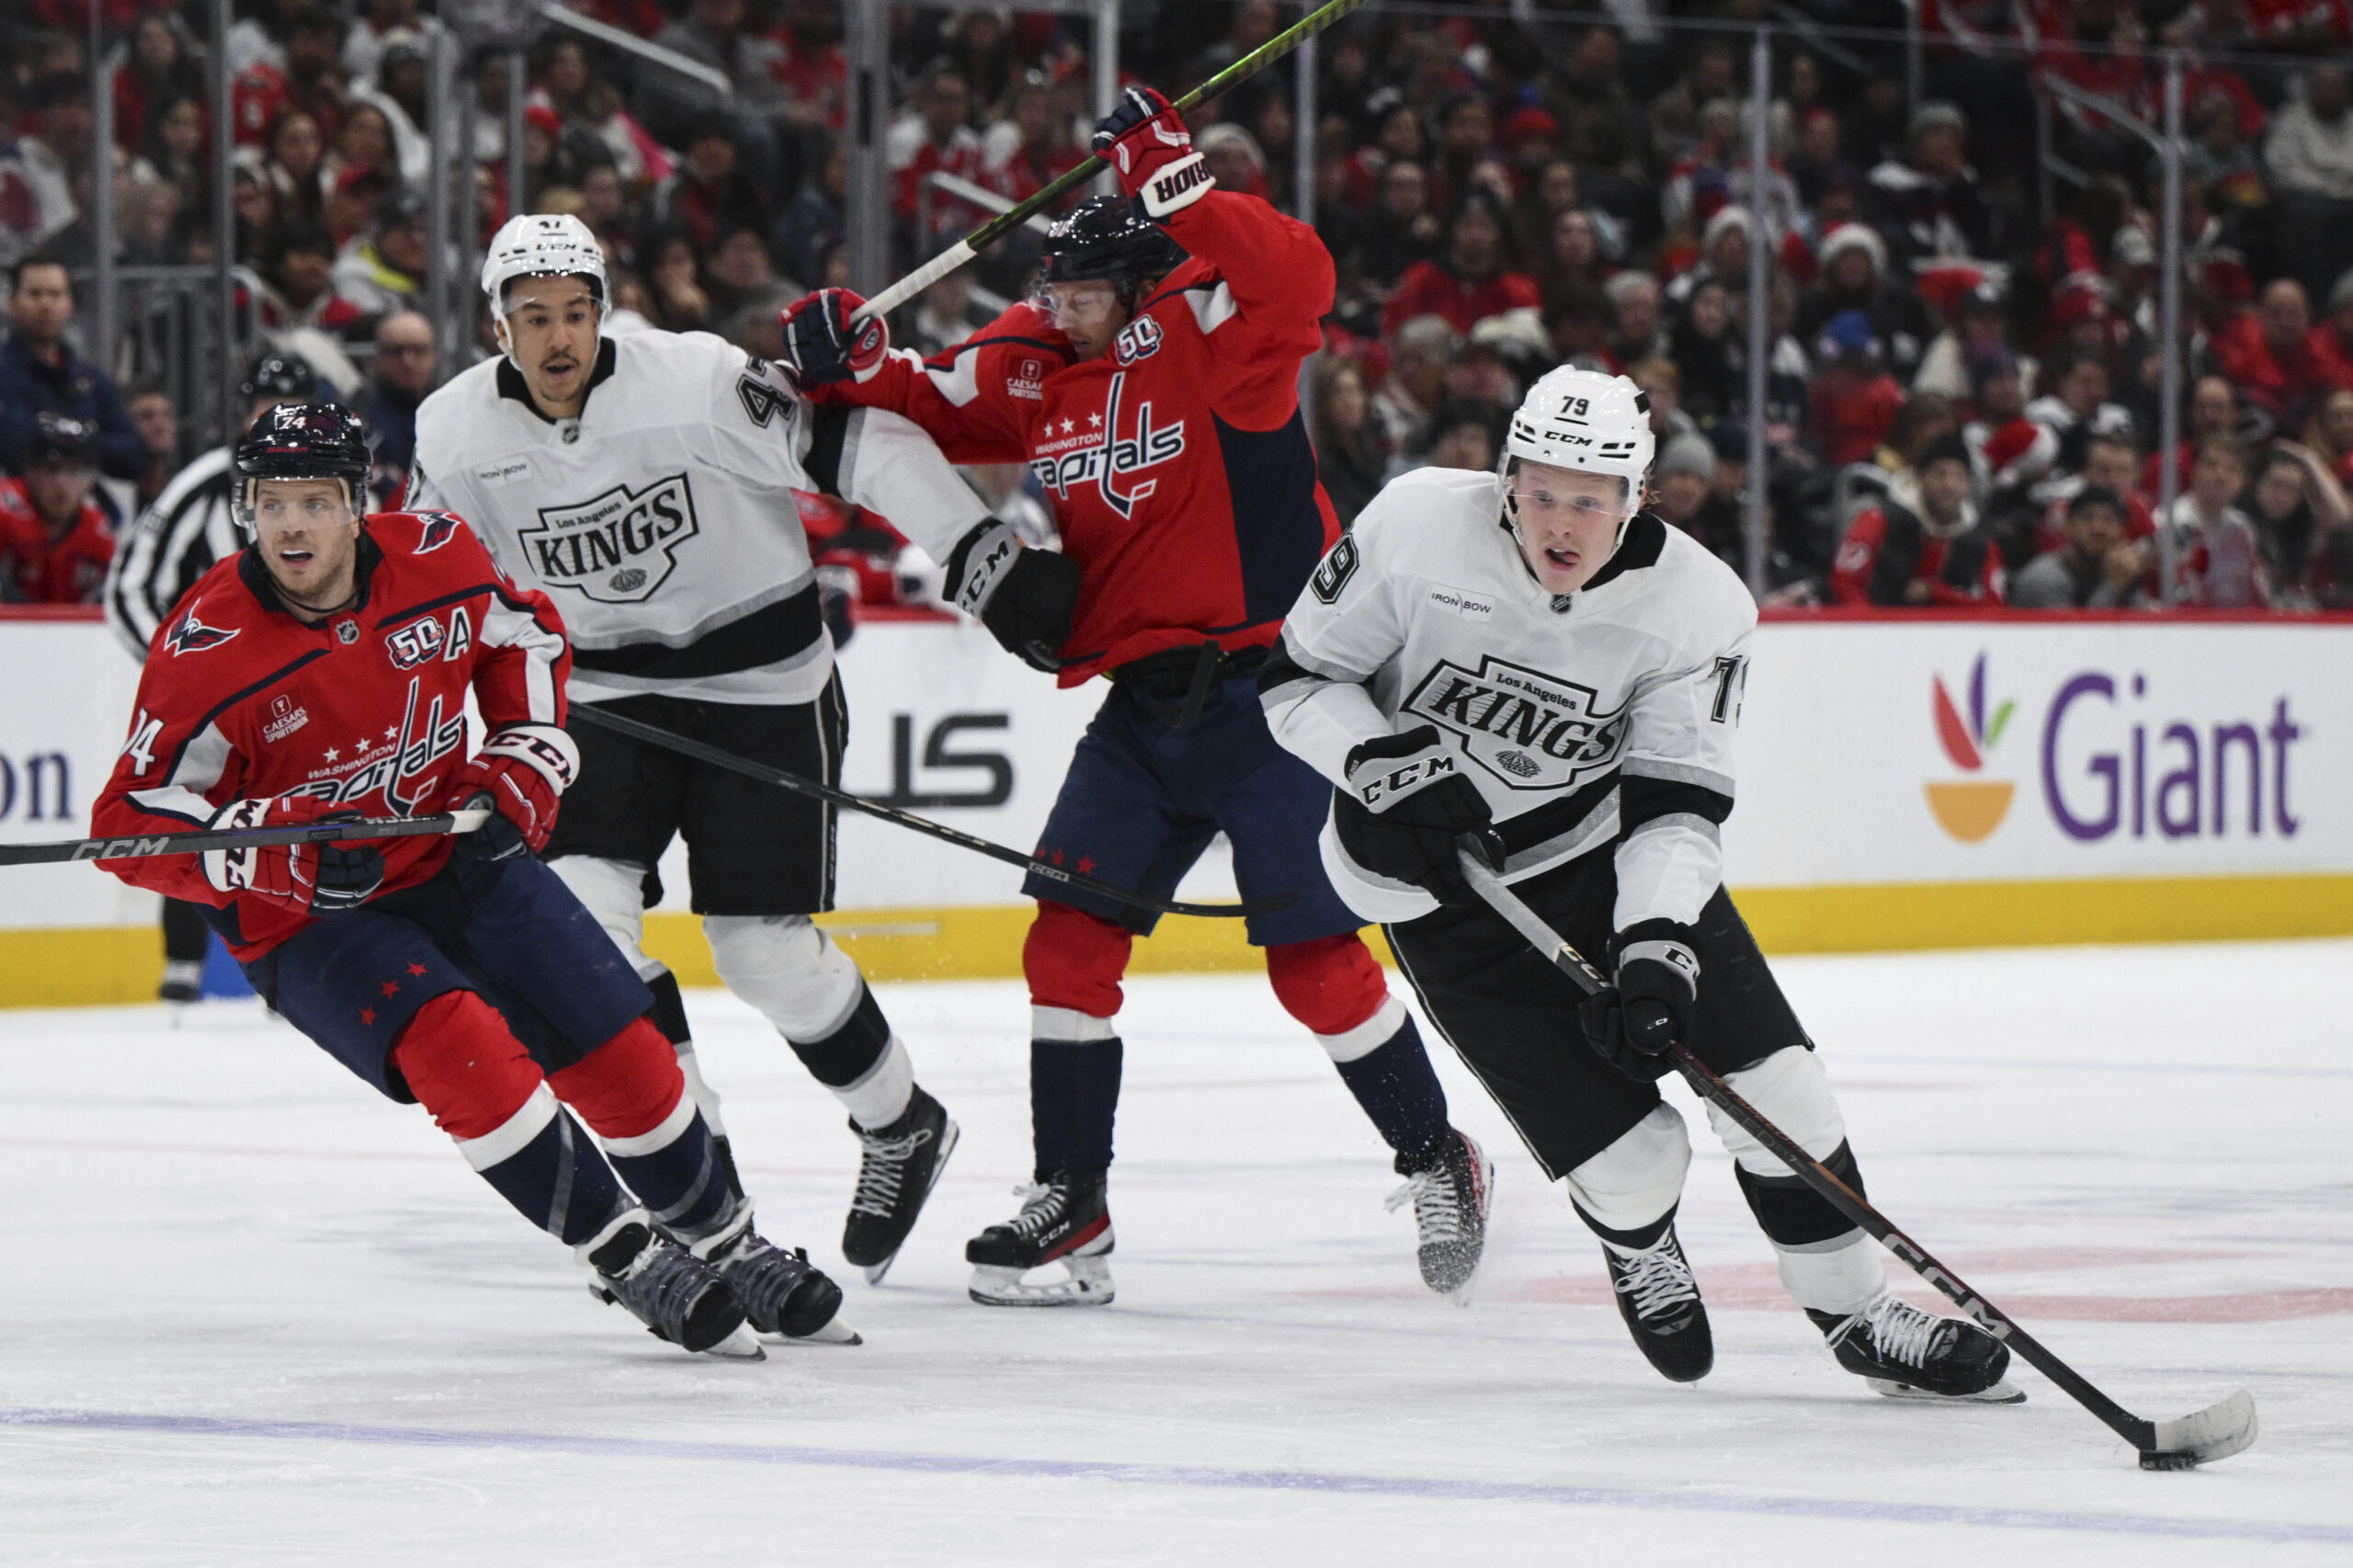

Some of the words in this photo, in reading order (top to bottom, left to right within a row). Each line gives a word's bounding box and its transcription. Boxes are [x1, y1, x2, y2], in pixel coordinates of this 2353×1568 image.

[1153, 158, 1210, 203] RIOR
[1117, 316, 1160, 361] 50
[278, 415, 307, 429] 74
[1560, 395, 1589, 416] 79
[1035, 432, 1103, 455] WASHINGTON
[1544, 430, 1593, 446] CCM
[534, 488, 683, 577] KINGS
[555, 518, 575, 529] Los
[577, 502, 621, 527] Angeles
[1309, 519, 1360, 606] 9
[1430, 592, 1460, 608] IRON
[1462, 600, 1493, 614] BOW
[388, 617, 444, 665] 50
[443, 606, 472, 663] A
[1496, 673, 1523, 688] Los
[1522, 681, 1577, 710] Angeles
[1707, 654, 1750, 729] 7
[263, 706, 307, 734] CAESARS
[1429, 676, 1626, 762] KINGS
[308, 743, 396, 779] WASHINGTON
[2040, 672, 2300, 841] Giant
[1361, 756, 1455, 805] CCM
[70, 836, 170, 861] CCM
[1030, 863, 1068, 881] CCM
[1665, 1049, 1776, 1148] ETSPEED
[1038, 1220, 1071, 1248] CCM
[1881, 1233, 2015, 1340] CCM
